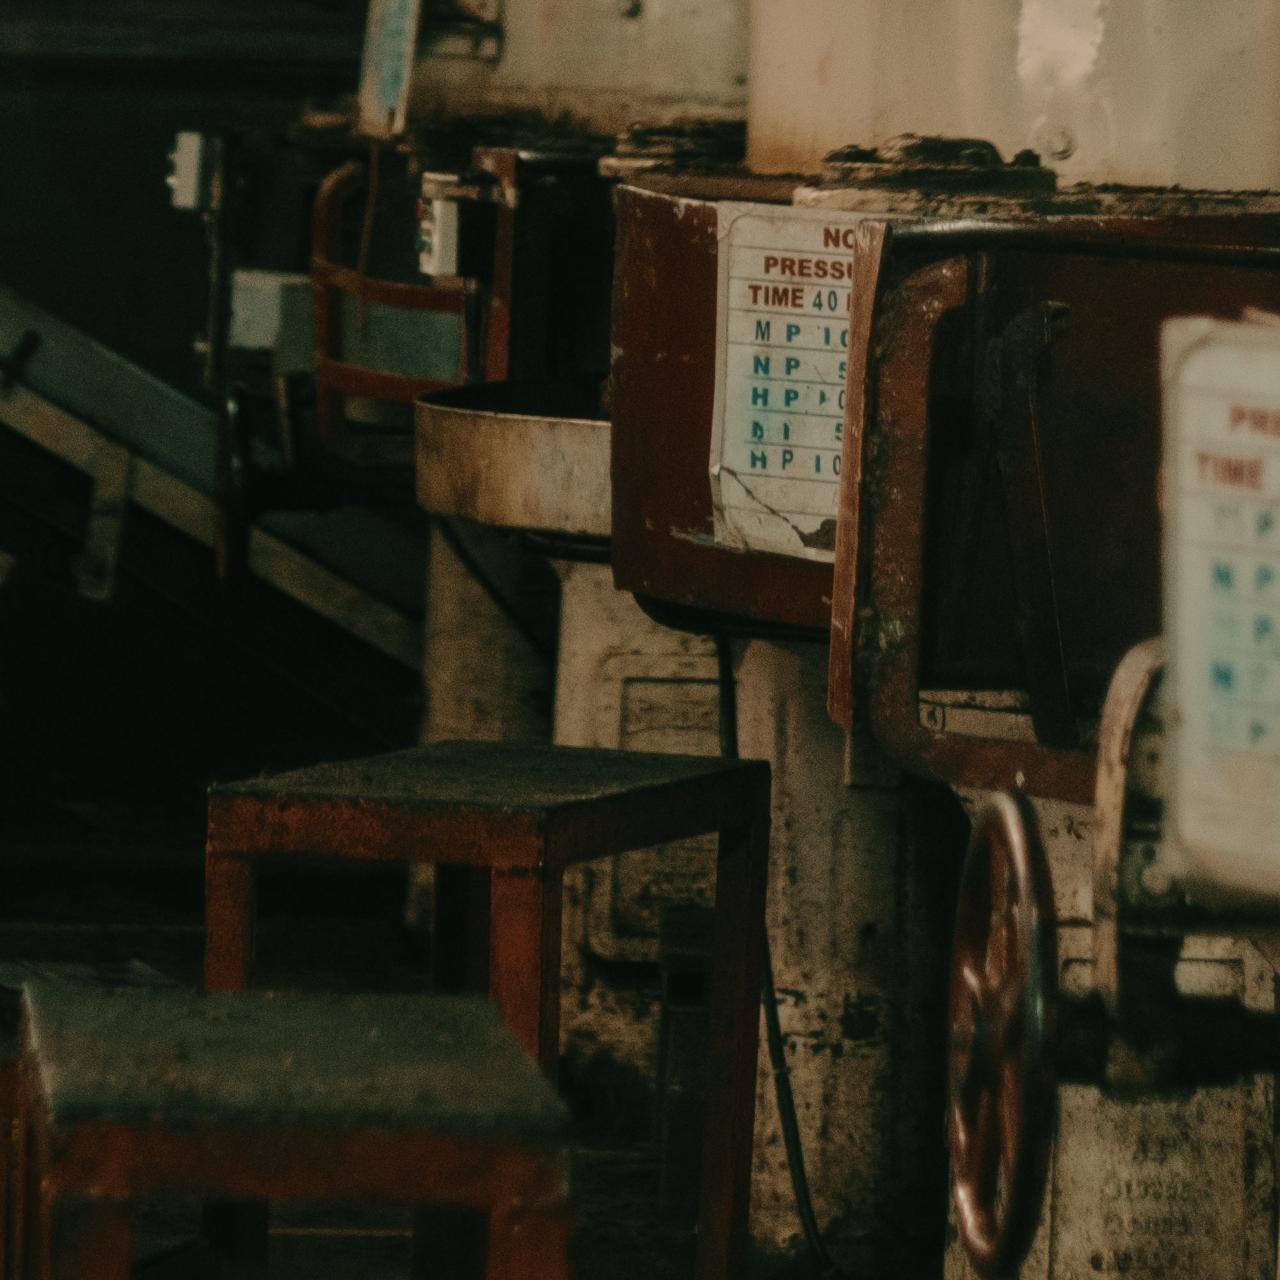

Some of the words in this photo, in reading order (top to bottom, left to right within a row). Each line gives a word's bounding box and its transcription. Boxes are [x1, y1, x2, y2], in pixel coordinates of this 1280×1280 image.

[748, 284, 804, 308] TIME
[755, 320, 770, 342] M
[786, 323, 800, 343] P
[753, 355, 770, 376] N
[785, 357, 800, 376] P
[751, 386, 769, 407] H
[784, 388, 799, 407] P
[750, 450, 767, 469] H
[782, 449, 794, 471] P
[1196, 451, 1264, 491] TIME
